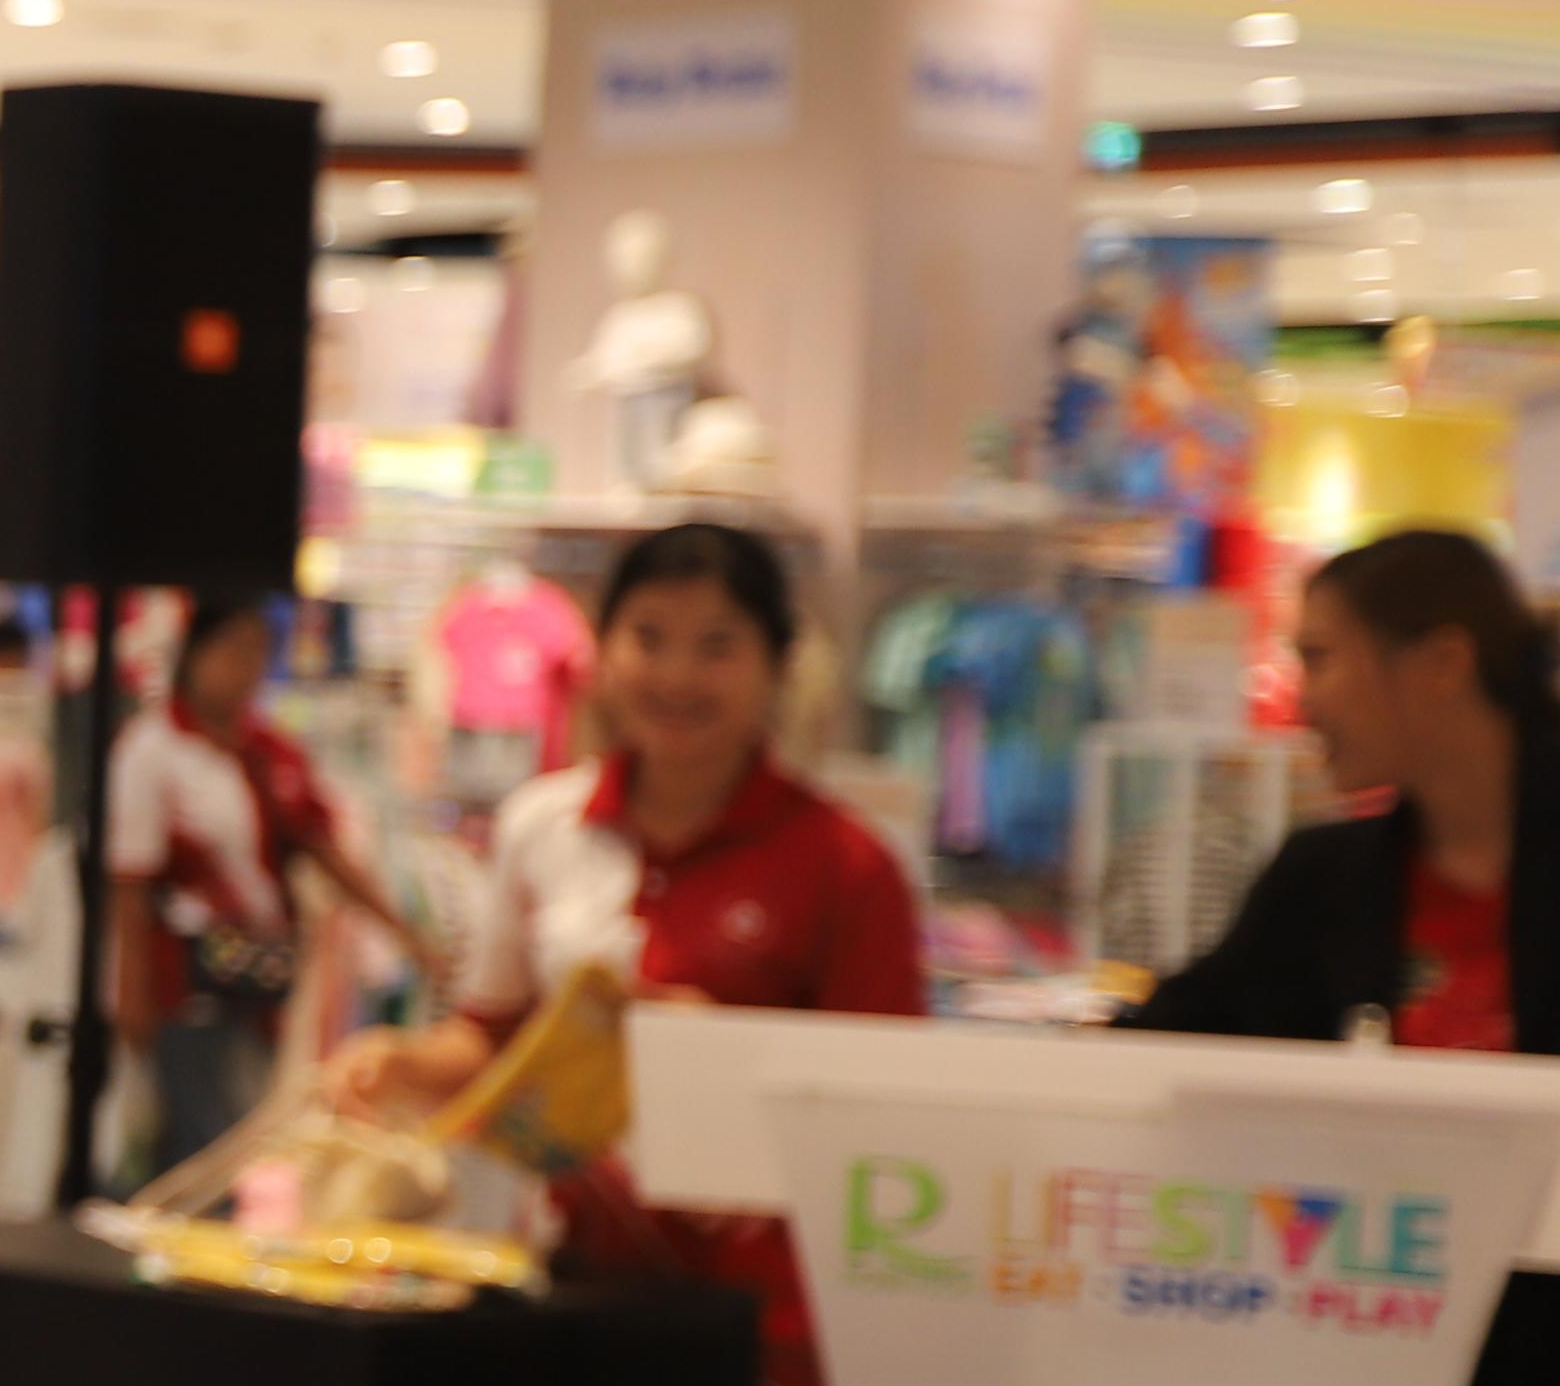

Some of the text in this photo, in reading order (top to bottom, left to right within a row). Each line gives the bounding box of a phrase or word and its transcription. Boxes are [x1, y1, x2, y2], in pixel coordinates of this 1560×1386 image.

[992, 1166, 1450, 1281] LIFESTYLE
[1124, 1266, 1273, 1318] SHOP
[1306, 1279, 1447, 1335] PLAY
